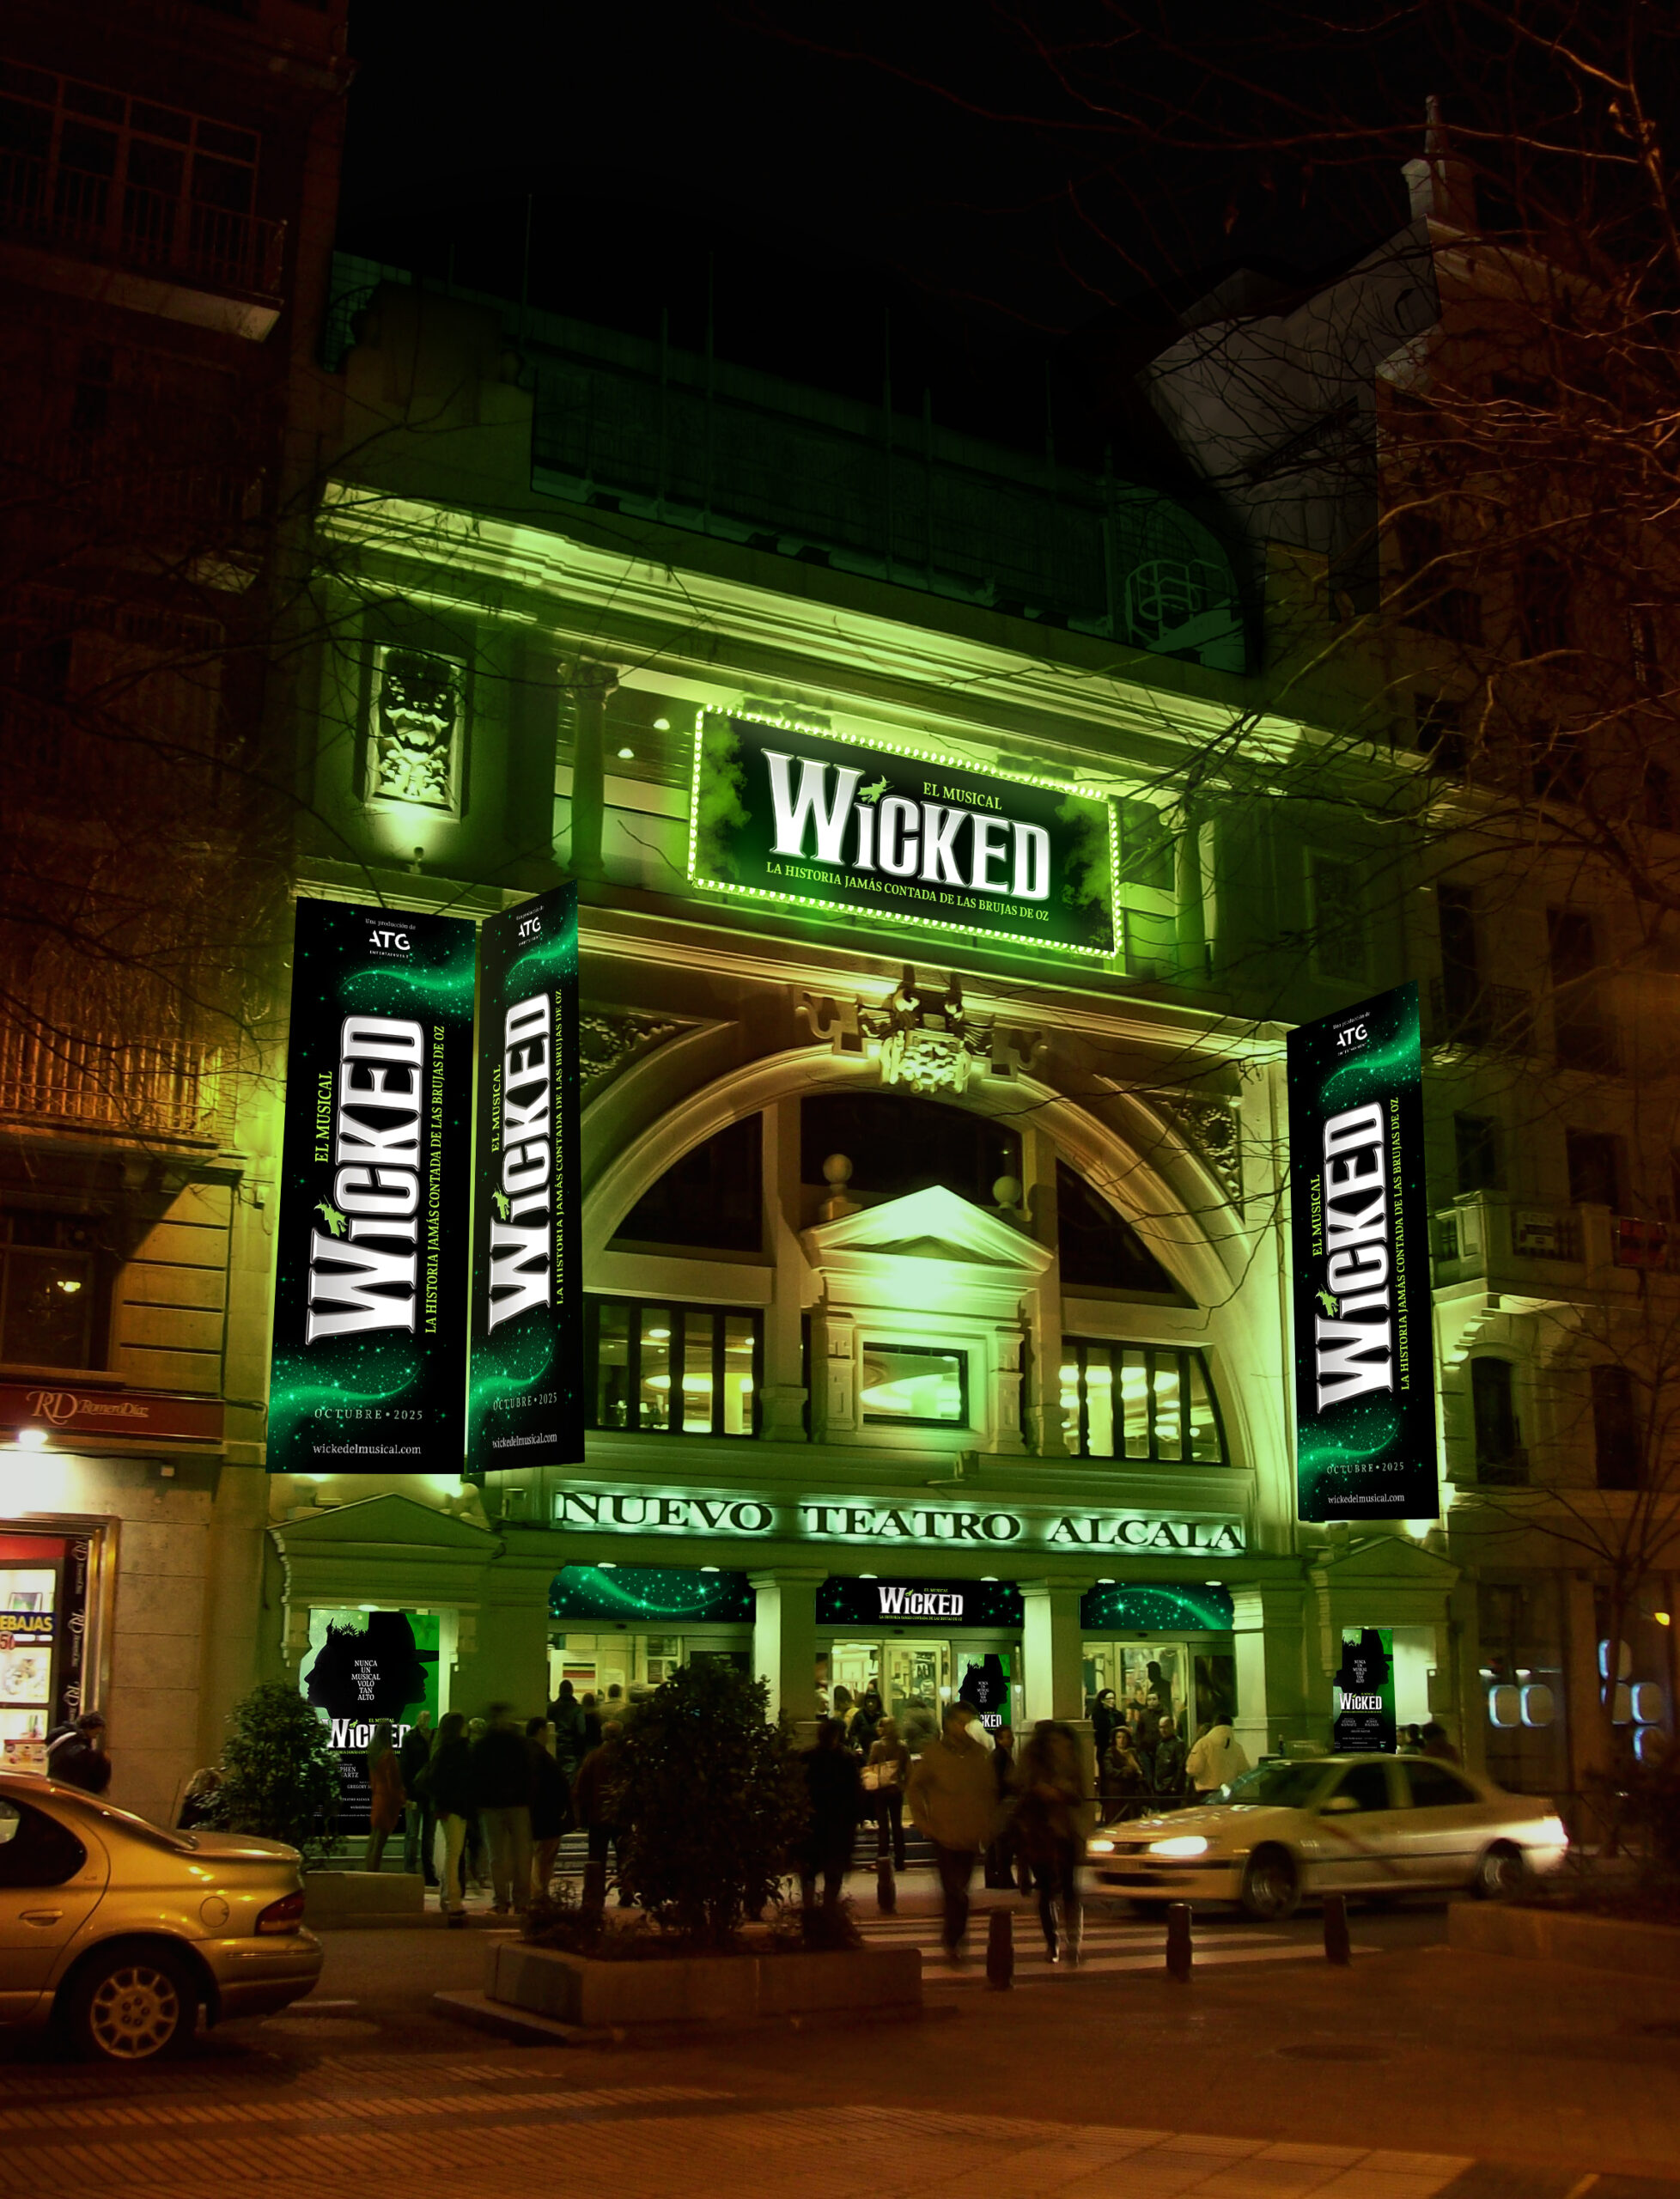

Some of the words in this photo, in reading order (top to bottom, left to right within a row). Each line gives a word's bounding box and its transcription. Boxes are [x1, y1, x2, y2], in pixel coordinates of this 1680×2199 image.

[923, 782, 940, 797] EL
[942, 786, 1002, 810] MUSICAL
[766, 862, 782, 874] LA
[784, 865, 842, 886] HISTORIA
[844, 875, 882, 892] JAMÁS
[884, 883, 936, 902] CONTADA
[940, 892, 955, 905] DE
[957, 896, 976, 909] LAS
[978, 899, 1017, 916] BRUJAS
[1020, 906, 1034, 918] DE
[1036, 910, 1049, 921] OZ
[519, 917, 541, 937] ATG
[369, 930, 411, 950] ATG
[555, 989, 562, 1004] OZ
[556, 1005, 563, 1021] DE
[434, 1026, 445, 1040] OZ
[1336, 1024, 1367, 1047] ATG
[433, 1043, 445, 1059] DE
[432, 1061, 445, 1105] BRUJAS
[316, 1070, 332, 1140] MUSICAL
[492, 1064, 501, 1131] MUSICAL
[556, 1092, 563, 1110] DE
[1390, 1097, 1399, 1112] OZ
[431, 1106, 442, 1129] LAS
[1391, 1114, 1400, 1130] DE
[430, 1131, 441, 1148] DE
[491, 1133, 500, 1153] EL
[314, 1143, 329, 1163] EL
[1391, 1131, 1402, 1174] BRUJAS
[429, 1150, 441, 1209] CONTADA
[1393, 1175, 1403, 1197] LAS
[555, 1173, 565, 1215] JAMÁS
[1311, 1174, 1322, 1237] MUSICAL
[1394, 1199, 1403, 1216] DE
[426, 1209, 440, 1251] JAMÁS
[556, 1219, 564, 1284] HISTORIA
[1312, 1239, 1323, 1257] EL
[1395, 1217, 1406, 1273] CONTADA
[426, 1254, 439, 1314] HISTORIA
[1395, 1275, 1409, 1313] JAMÁS
[557, 1287, 563, 1305] LA
[425, 1317, 436, 1333] LA
[1398, 1315, 1409, 1372] HISTORIA
[1401, 1374, 1409, 1391] LA
[493, 1395, 533, 1410] OCTUBRE
[539, 1392, 557, 1405] 2025
[314, 1409, 382, 1419] OCTUBRE
[394, 1410, 423, 1420] 2025
[313, 1444, 422, 1454] wickedelmusical.com
[492, 1433, 557, 1448] wickedelmusical.com
[1326, 1463, 1373, 1474] OCTUBRE
[1382, 1461, 1404, 1471] 2025
[1328, 1493, 1405, 1504] wickedelmusical.com
[556, 1491, 773, 1532] NUEVO
[801, 1504, 1021, 1541] TEATRO
[0, 1615, 53, 1632] EBAJAS
